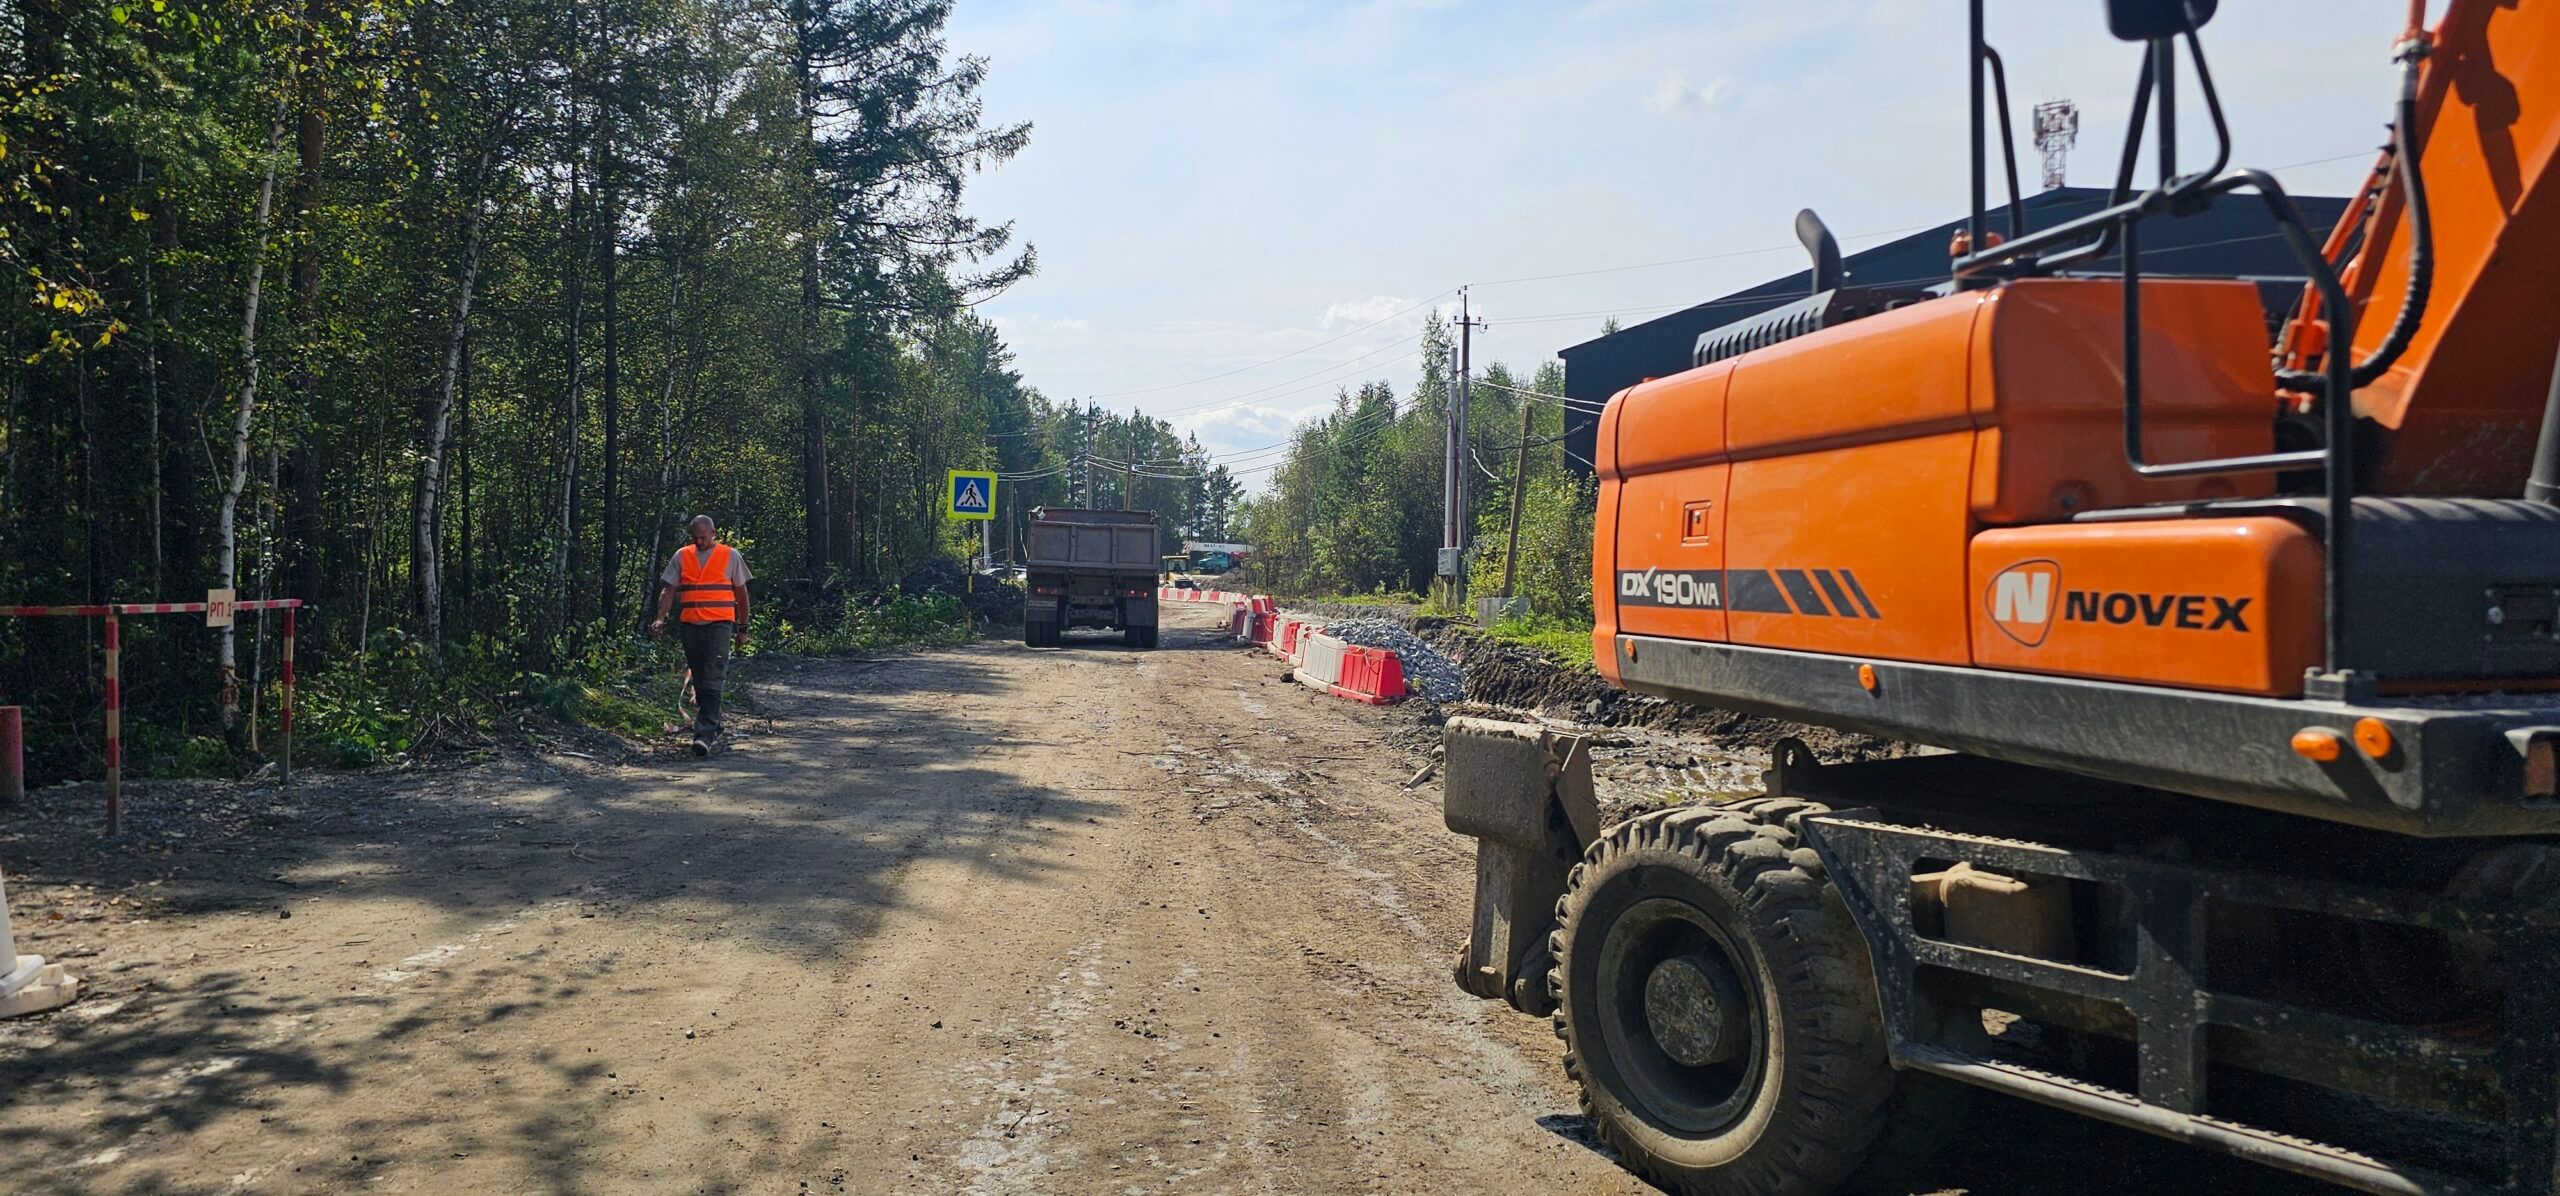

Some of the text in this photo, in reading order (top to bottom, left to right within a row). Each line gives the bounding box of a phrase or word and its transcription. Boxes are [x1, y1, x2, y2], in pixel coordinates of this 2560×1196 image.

[209, 602, 232, 617] РП 1
[1994, 571, 2051, 624] N
[2064, 591, 2253, 633] NOVEX
